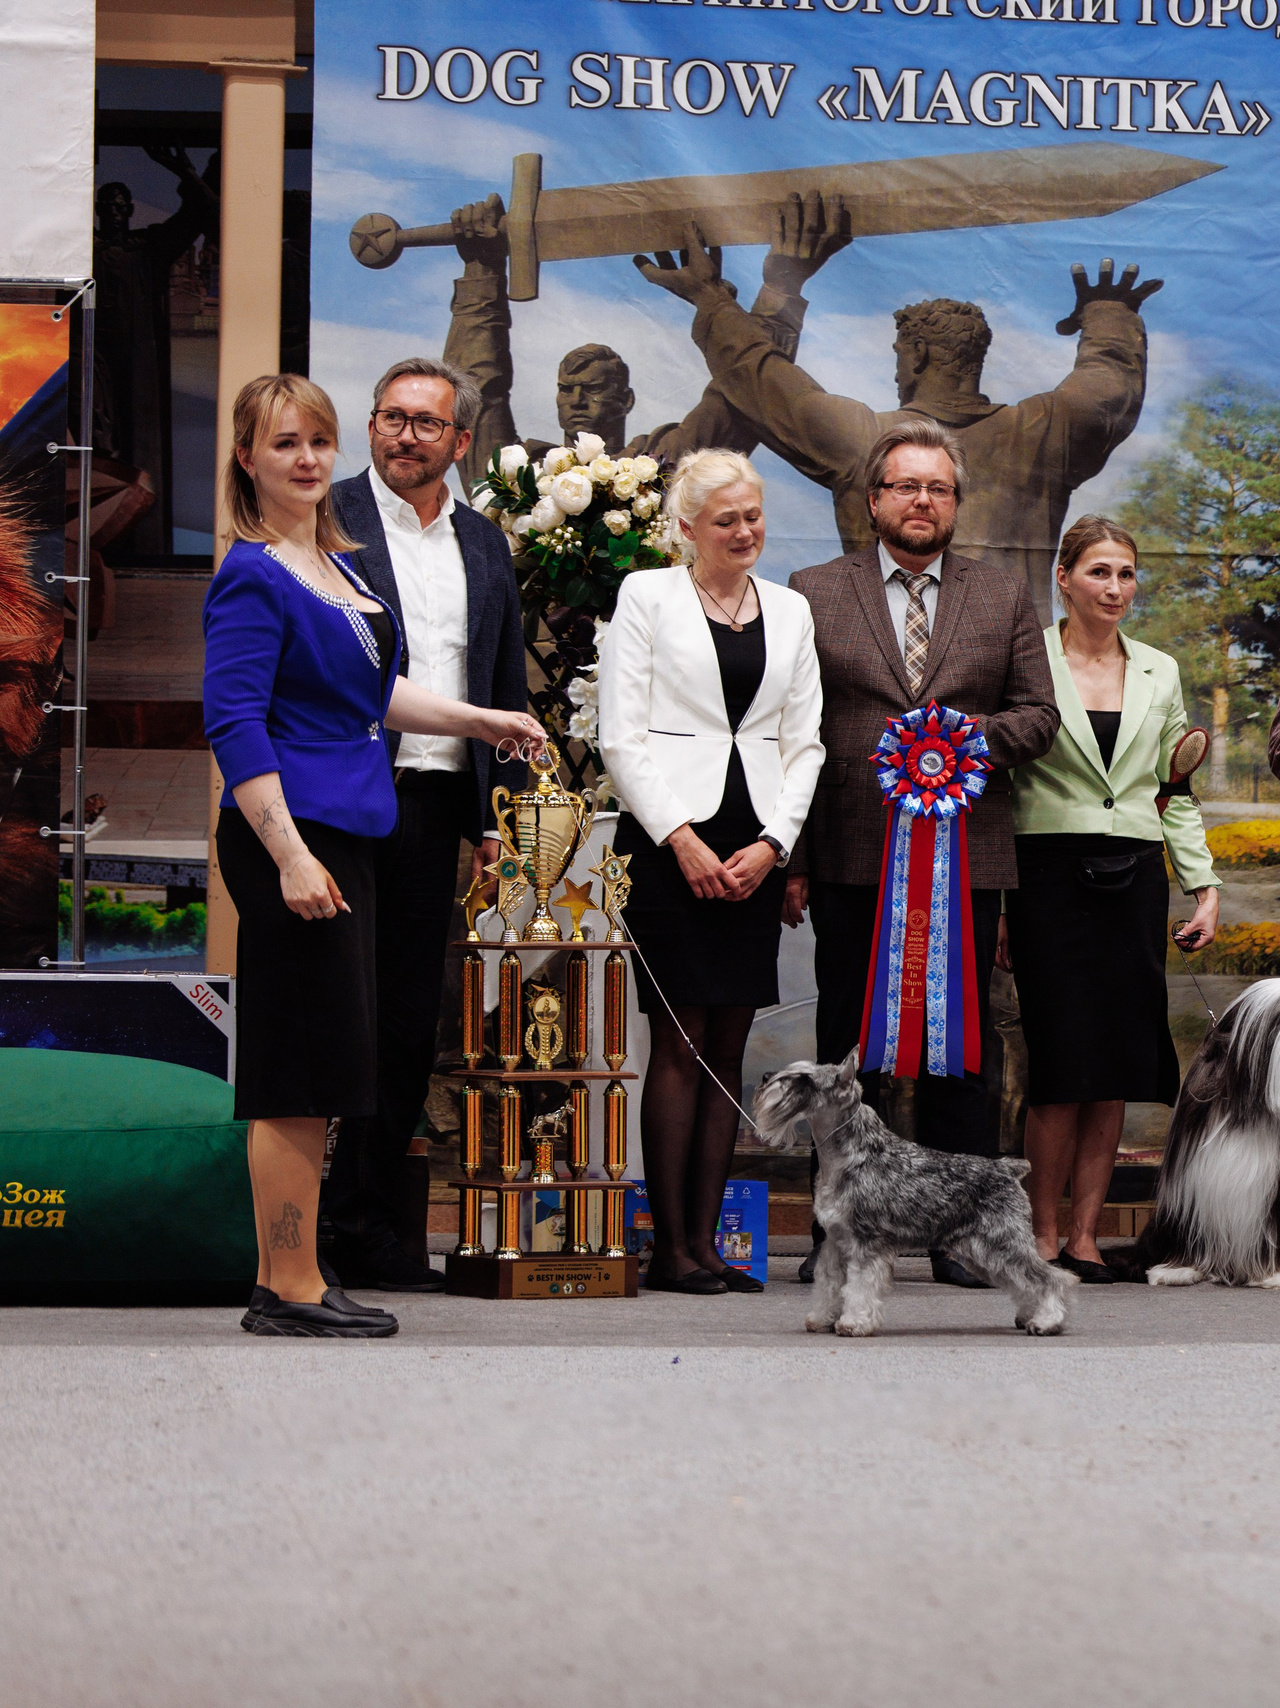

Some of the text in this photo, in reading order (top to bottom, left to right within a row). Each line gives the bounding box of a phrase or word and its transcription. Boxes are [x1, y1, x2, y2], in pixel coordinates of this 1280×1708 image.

[376, 45, 1271, 137] DOG SHOW «MAGNITKA»
[188, 983, 224, 1021] Slim
[0, 1181, 66, 1204] Зож
[1, 1209, 66, 1229] цея
